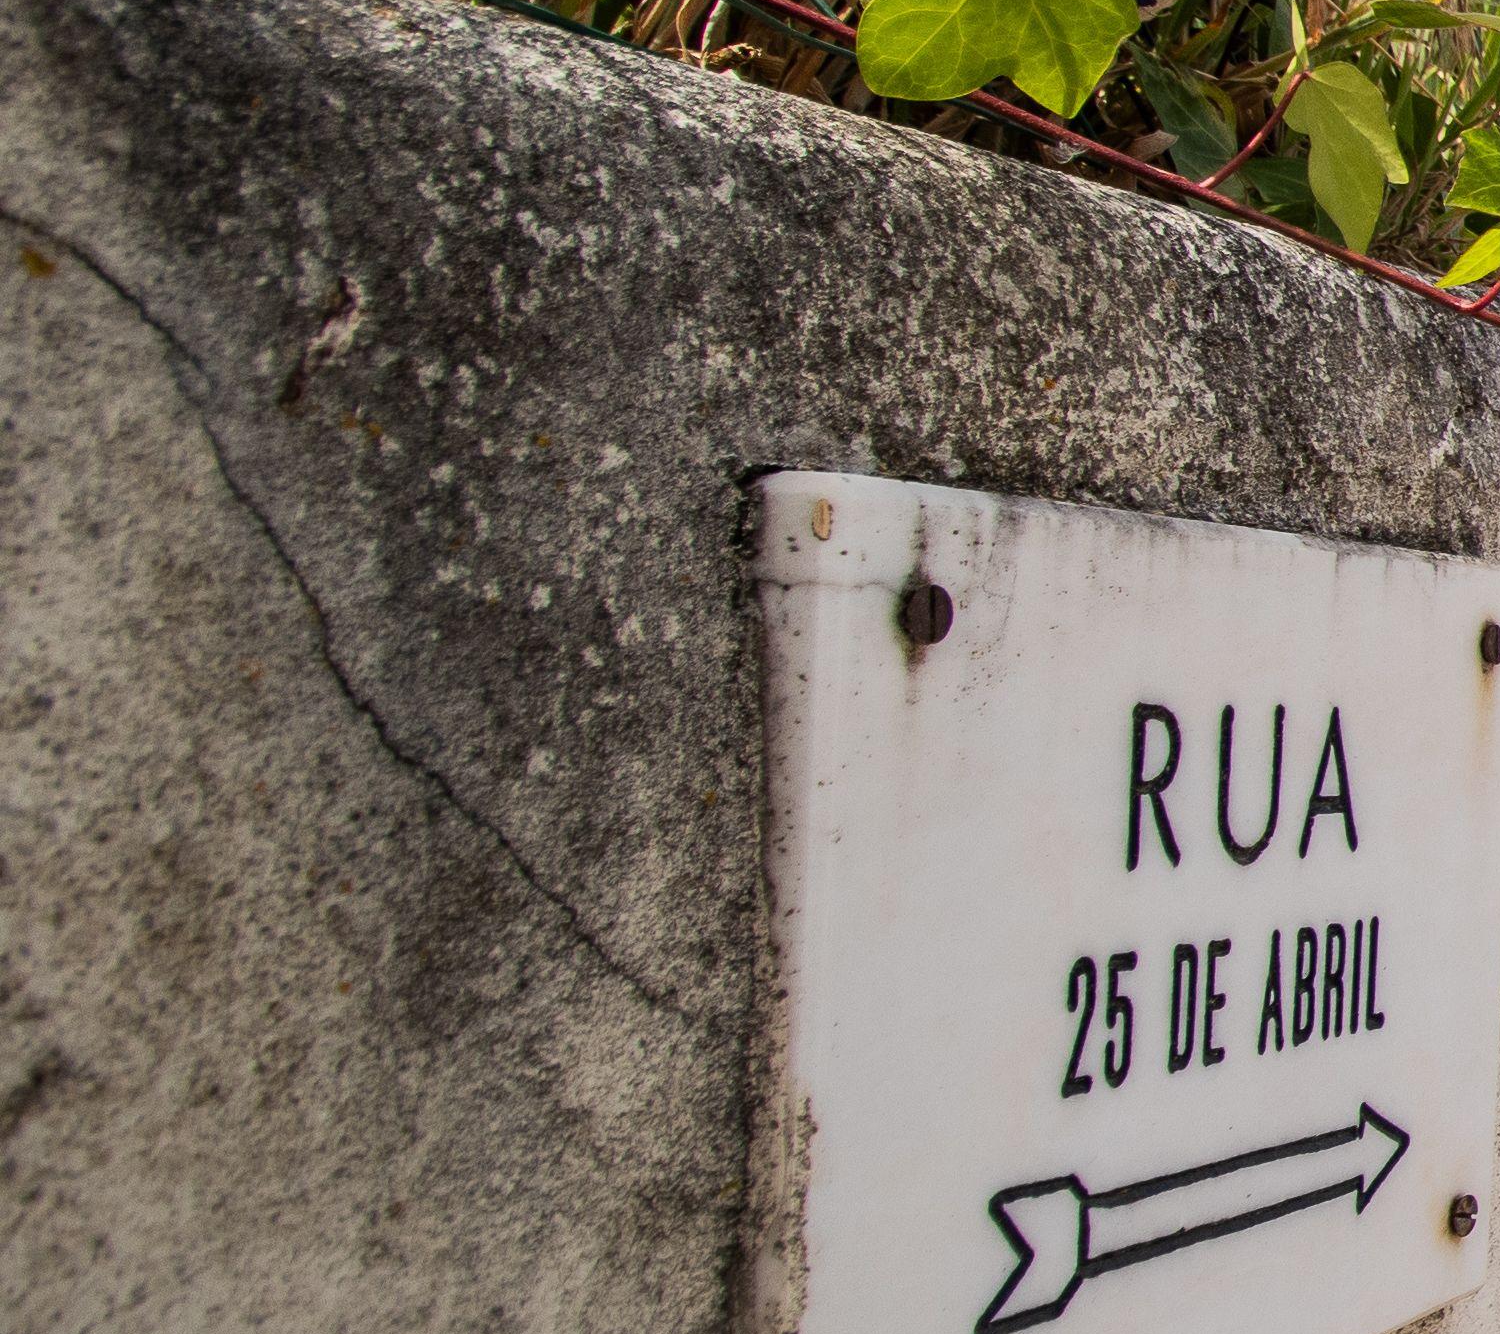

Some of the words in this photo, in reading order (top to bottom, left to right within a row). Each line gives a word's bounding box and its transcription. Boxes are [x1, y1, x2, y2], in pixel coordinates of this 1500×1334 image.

[1124, 700, 1360, 873] RUA
[1059, 949, 1140, 1100] 25
[1166, 936, 1233, 1076] DE
[1256, 914, 1387, 1057] ABRIL
